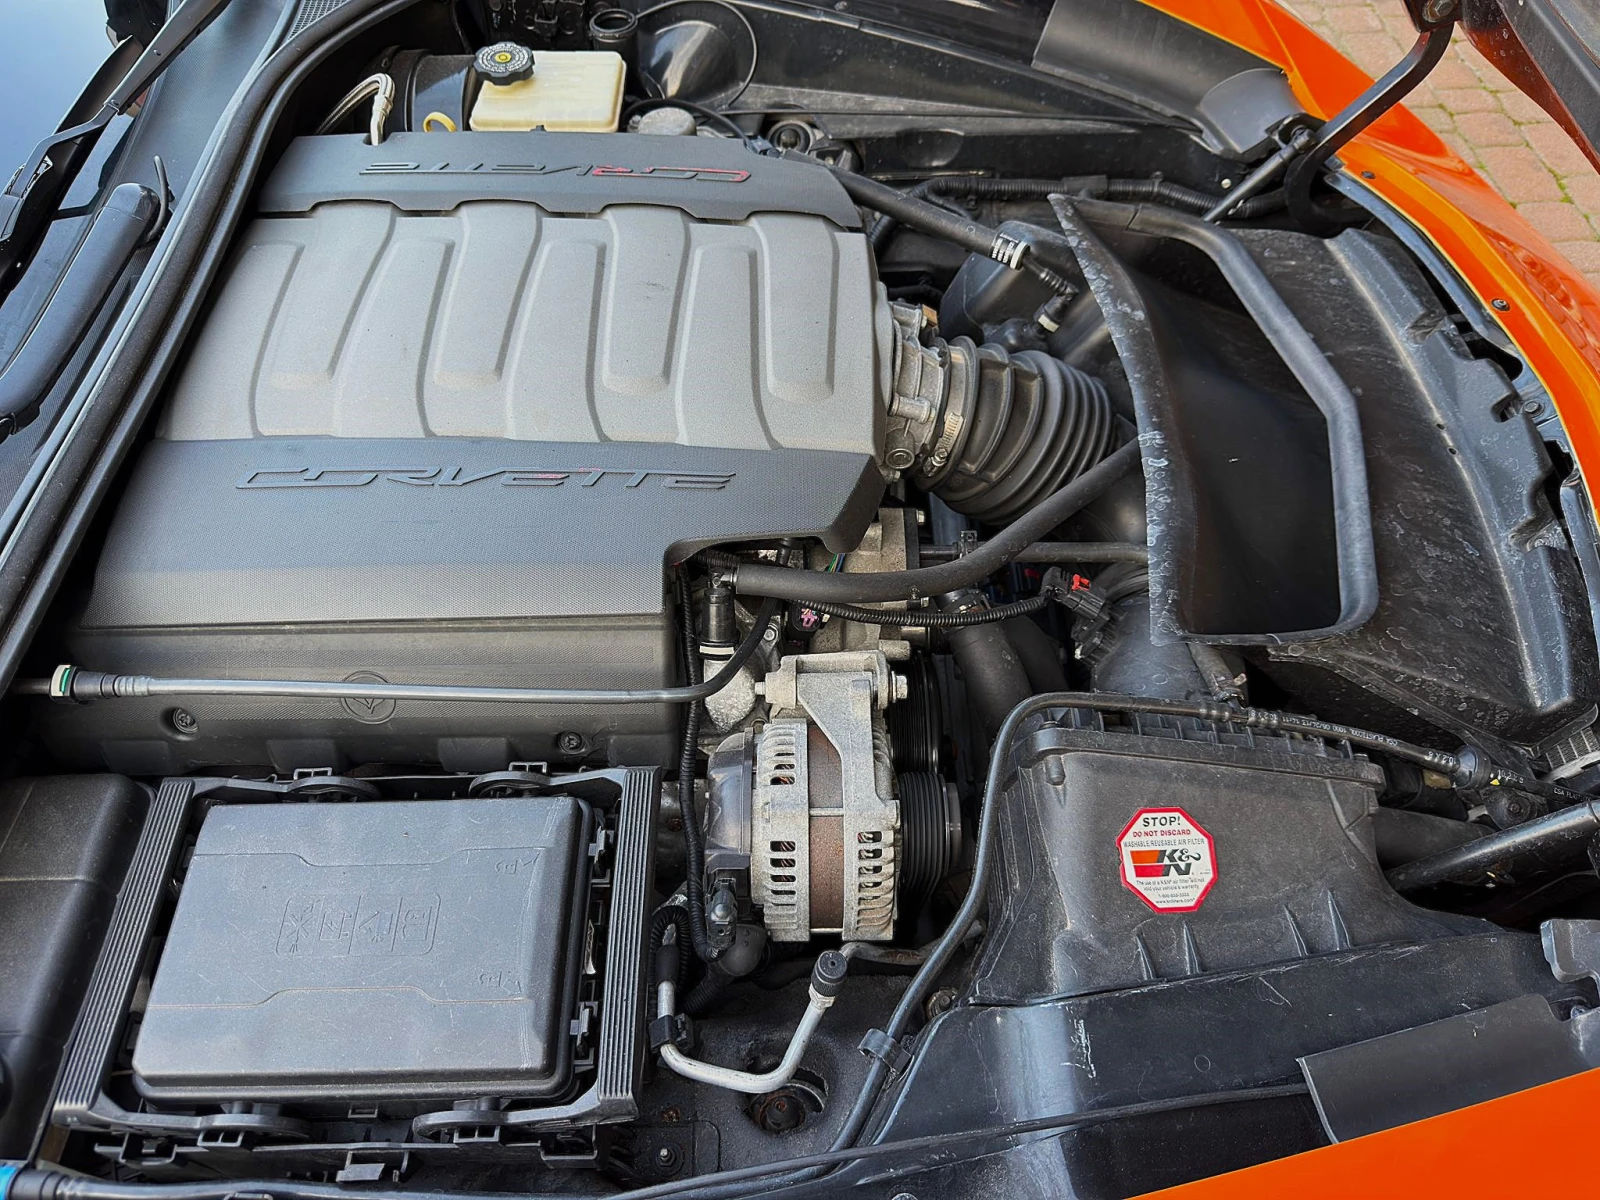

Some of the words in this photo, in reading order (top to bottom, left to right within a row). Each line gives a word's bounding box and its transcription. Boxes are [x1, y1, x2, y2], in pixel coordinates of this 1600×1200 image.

[359, 162, 752, 183] CORVETTE
[235, 466, 738, 490] CORVETTE
[1142, 816, 1181, 827] STOP!
[1160, 829, 1191, 837] DISCARD
